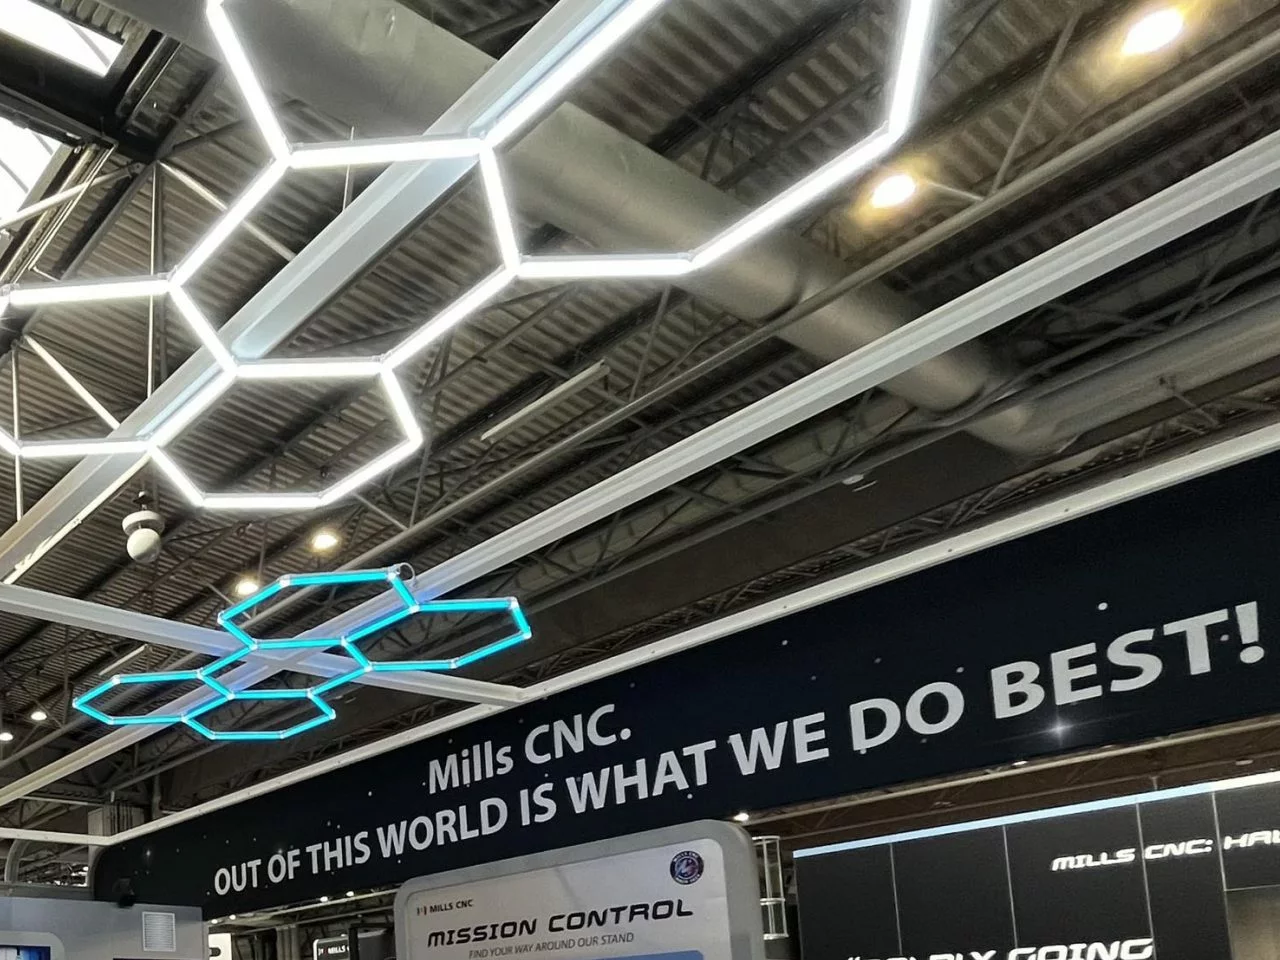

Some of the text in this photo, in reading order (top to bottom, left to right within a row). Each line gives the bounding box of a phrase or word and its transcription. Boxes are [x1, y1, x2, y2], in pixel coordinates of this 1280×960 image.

[214, 600, 1265, 896] OUT OF THIS WORLD IS WHAT WE DO BEST!
[427, 703, 632, 795] Mills CNC.
[1050, 848, 1135, 872] MILLS
[1144, 838, 1214, 860] CNC:
[427, 899, 694, 947] MISSION CONTROL
[429, 899, 474, 913] MILLS CNC
[469, 932, 634, 959] FIND YOUR WAY AROUND OUR STAND
